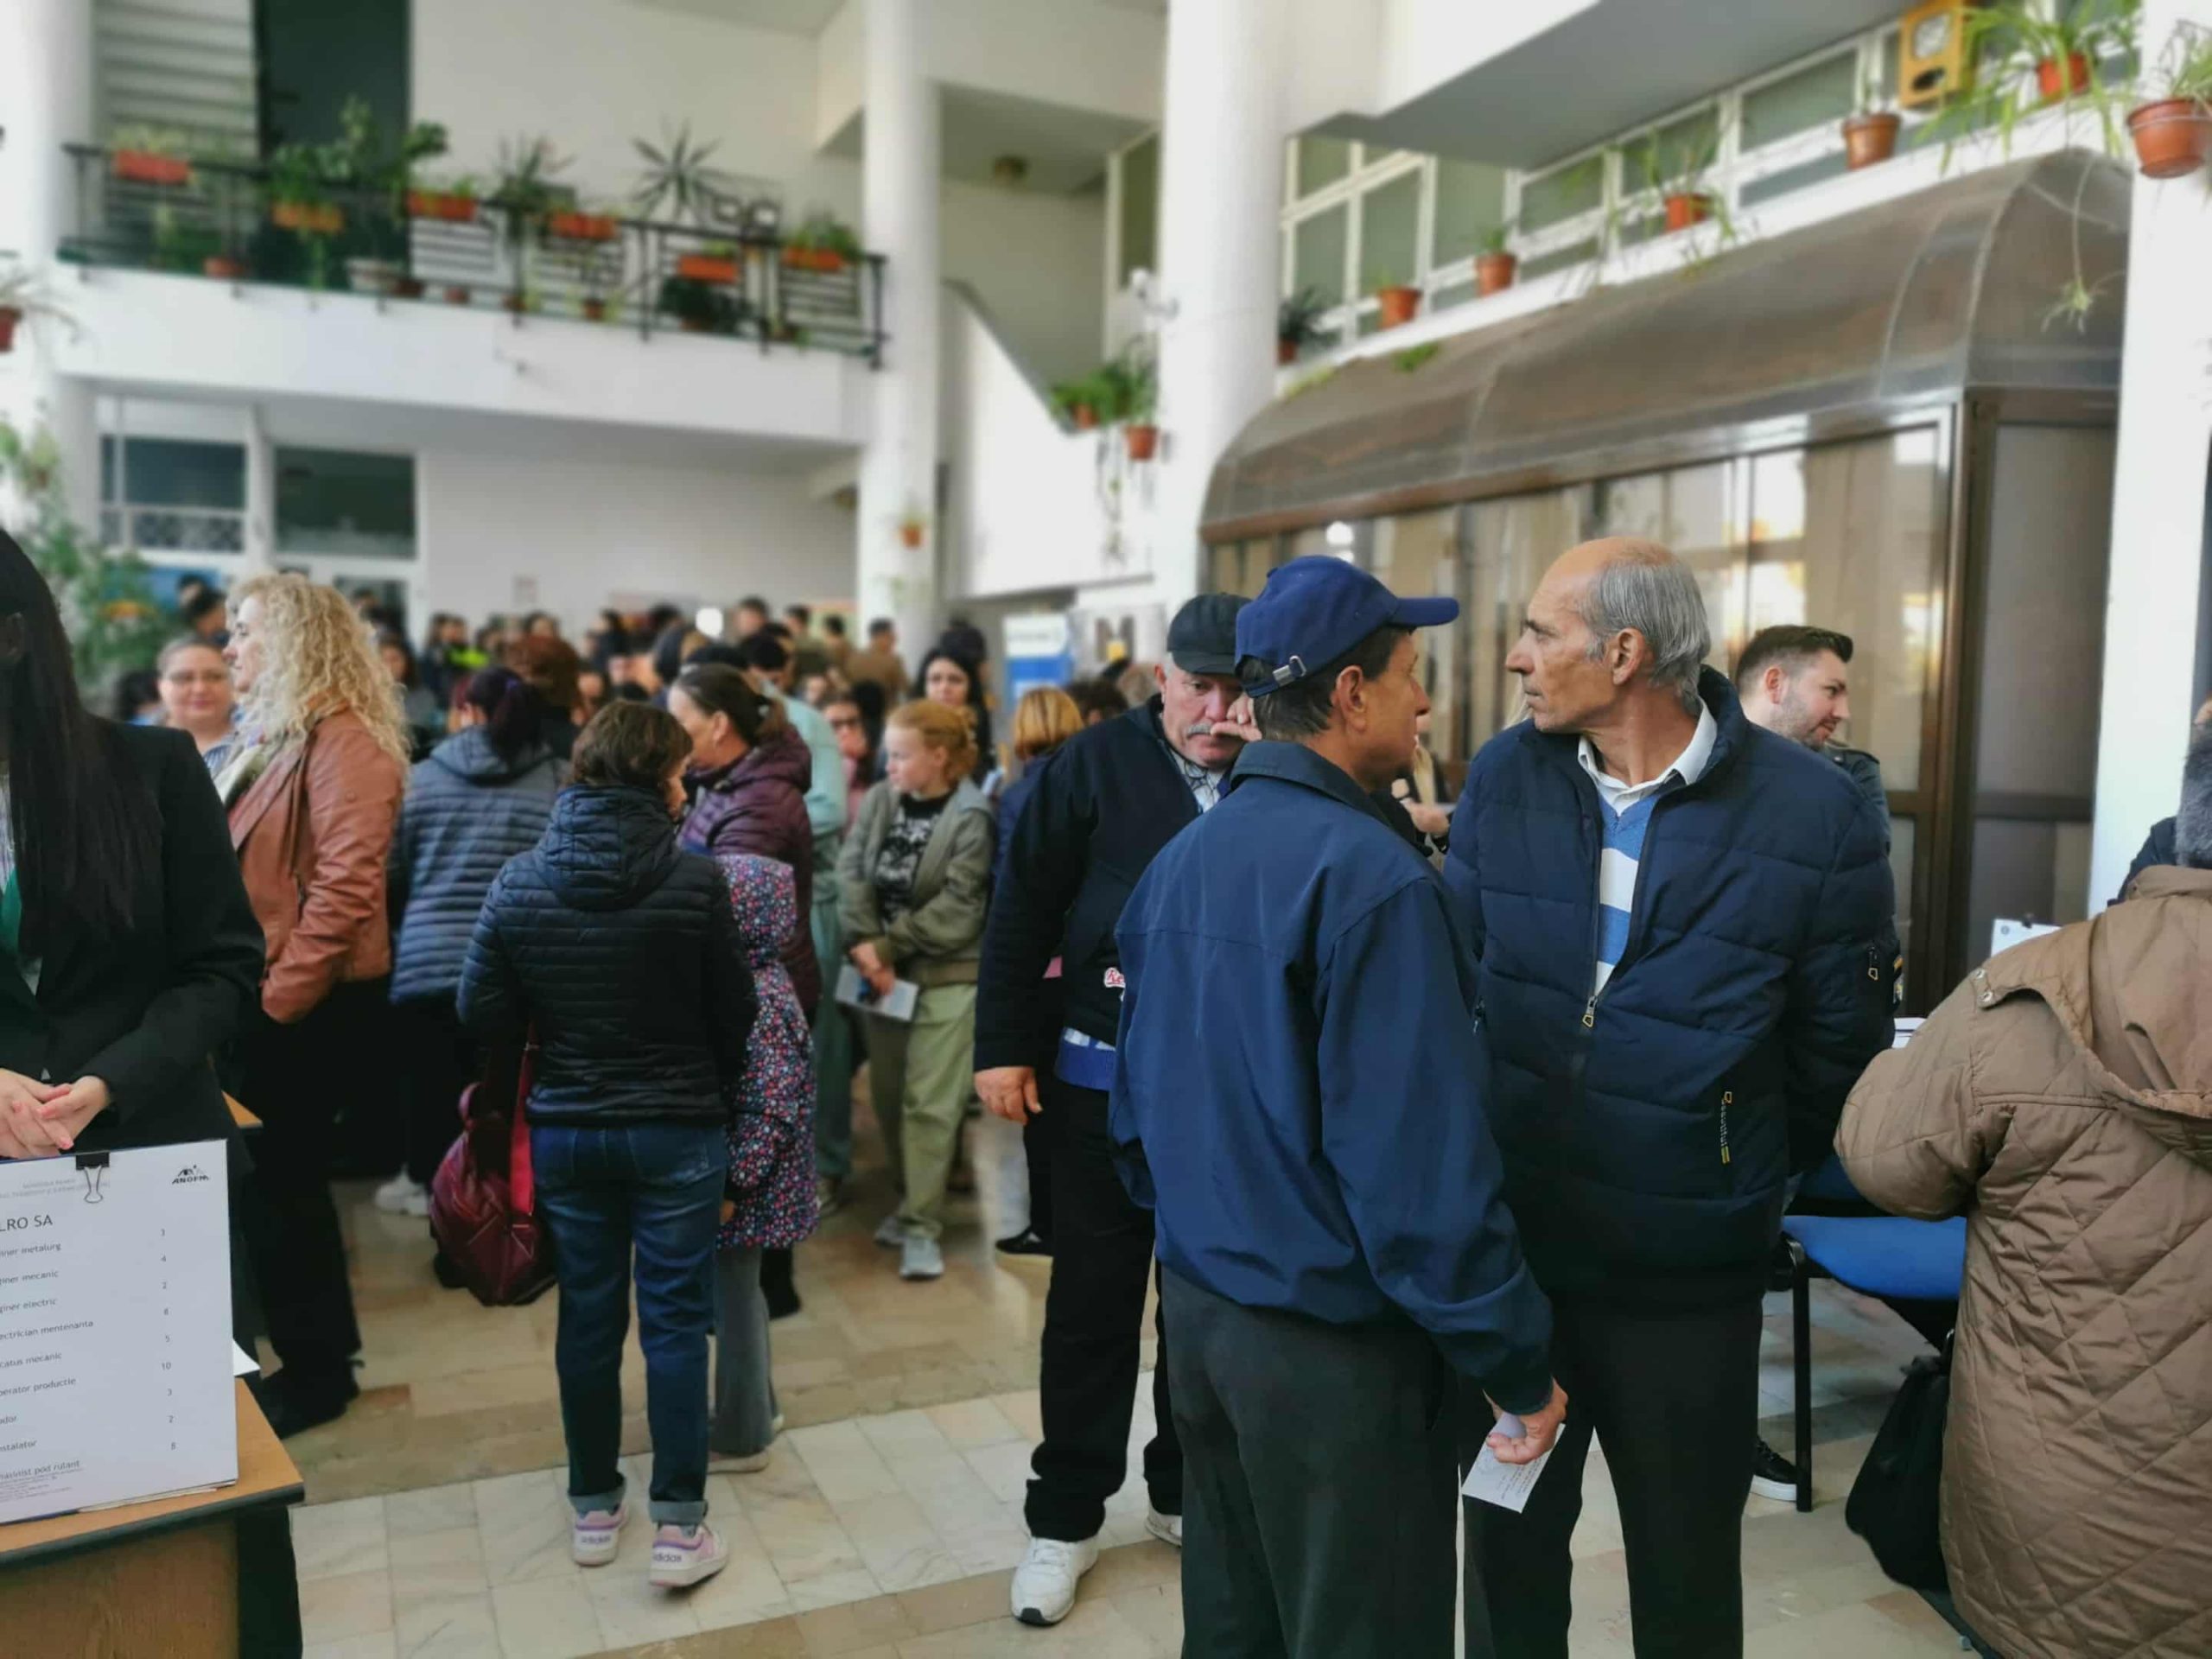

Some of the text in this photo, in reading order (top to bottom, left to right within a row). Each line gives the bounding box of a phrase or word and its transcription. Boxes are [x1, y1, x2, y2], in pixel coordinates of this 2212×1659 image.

[34, 1214, 54, 1228] SA
[22, 1270, 59, 1281] mecanic
[22, 1299, 57, 1309] electric
[162, 1362, 172, 1370] 10
